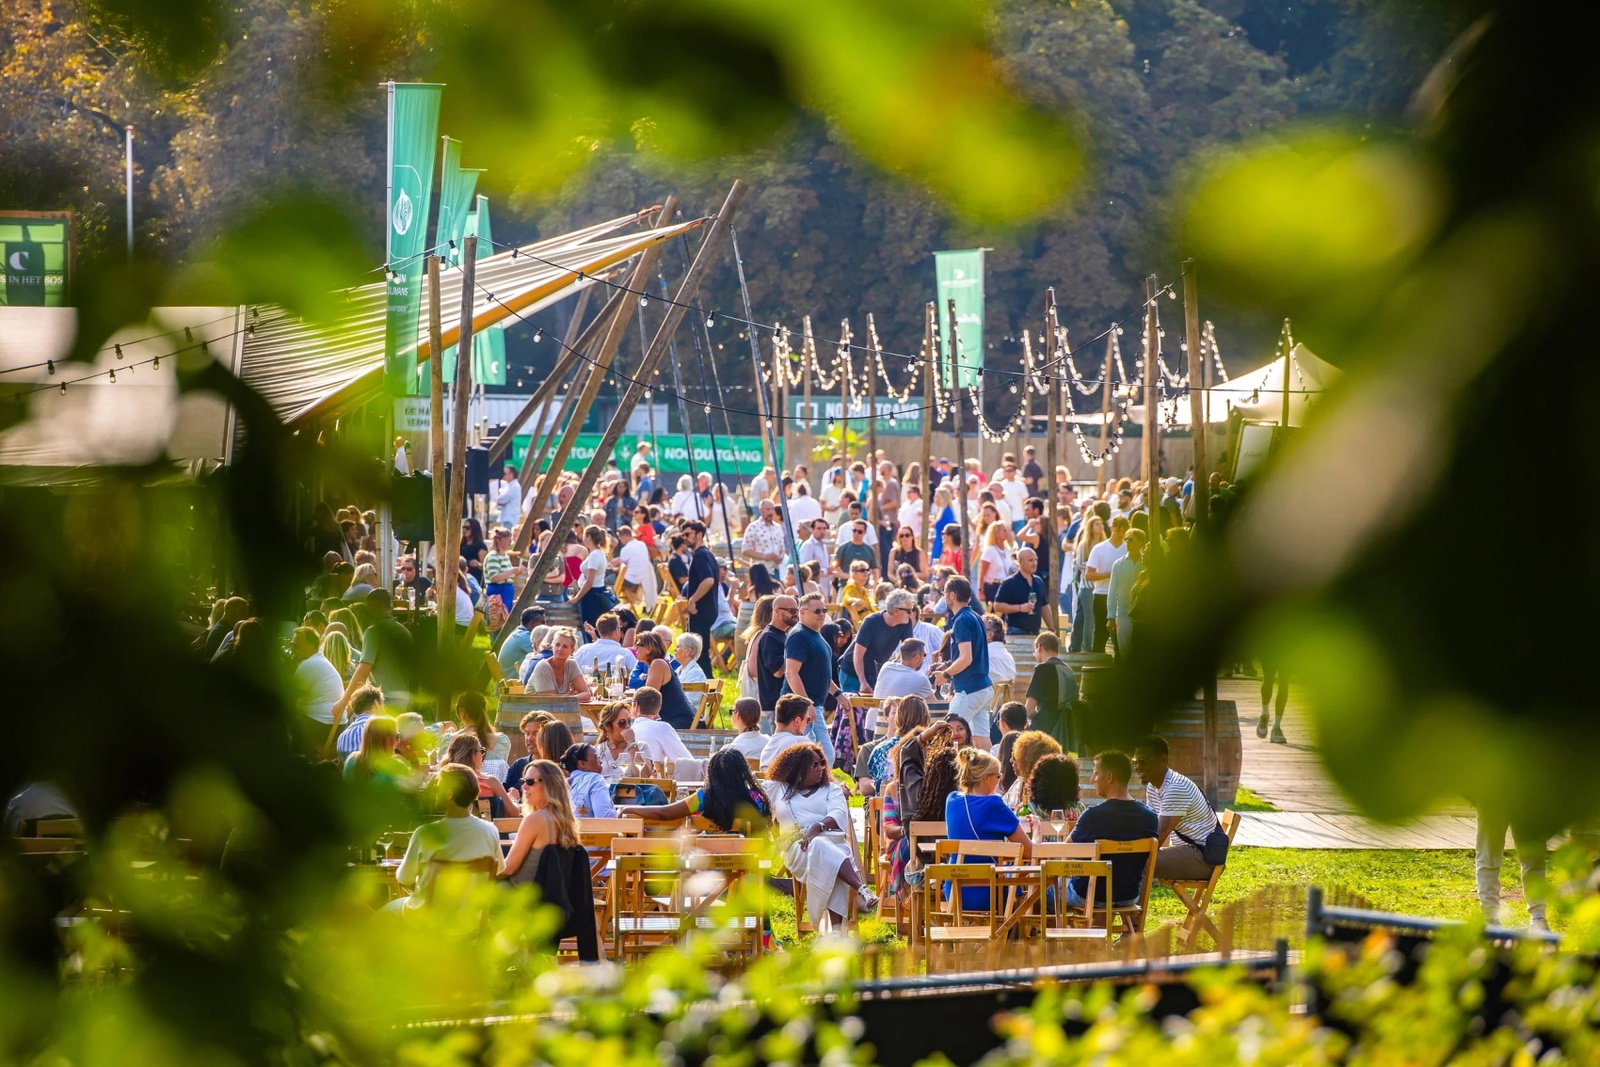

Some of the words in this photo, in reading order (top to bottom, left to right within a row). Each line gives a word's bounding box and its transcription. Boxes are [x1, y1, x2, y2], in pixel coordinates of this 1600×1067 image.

[9, 275, 20, 284] IN
[22, 275, 41, 285] HET
[44, 275, 63, 285] BOS
[664, 446, 762, 463] NOODUTGANG
